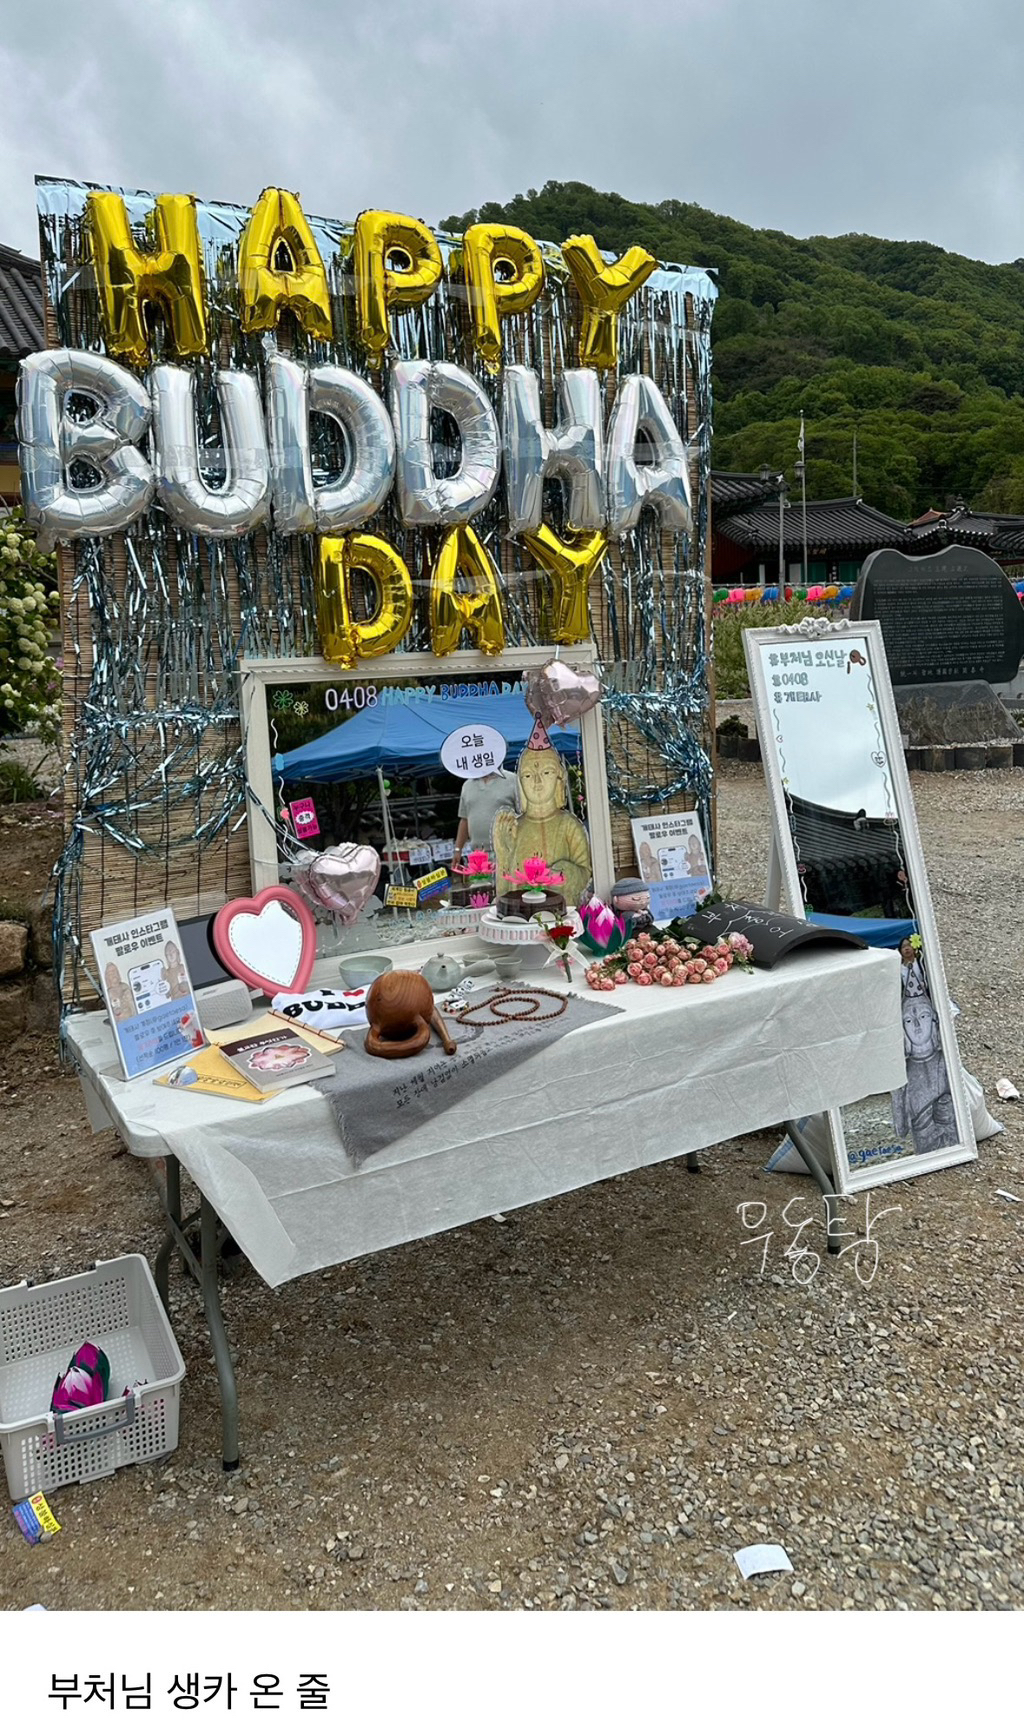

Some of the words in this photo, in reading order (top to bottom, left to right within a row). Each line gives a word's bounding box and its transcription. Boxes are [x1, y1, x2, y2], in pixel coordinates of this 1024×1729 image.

[85, 186, 658, 373] HAPPY
[16, 345, 693, 545] BUDDHA
[317, 521, 609, 668] DAY
[768, 649, 813, 667] #부처님
[815, 649, 847, 668] 오신날
[771, 672, 809, 687] #0408
[325, 685, 378, 711] 0408
[381, 685, 436, 706] HAPPY
[439, 680, 499, 701] BUDDHA
[461, 733, 485, 749] 오늘
[456, 757, 469, 771] 내
[471, 751, 495, 769] 생일
[662, 818, 694, 829] 인스타그램
[104, 931, 130, 947] 개태사
[130, 919, 169, 939] 인스타그램
[115, 941, 139, 957] 팔로우
[140, 933, 165, 949] 이벤트
[282, 999, 366, 1018] BUDD
